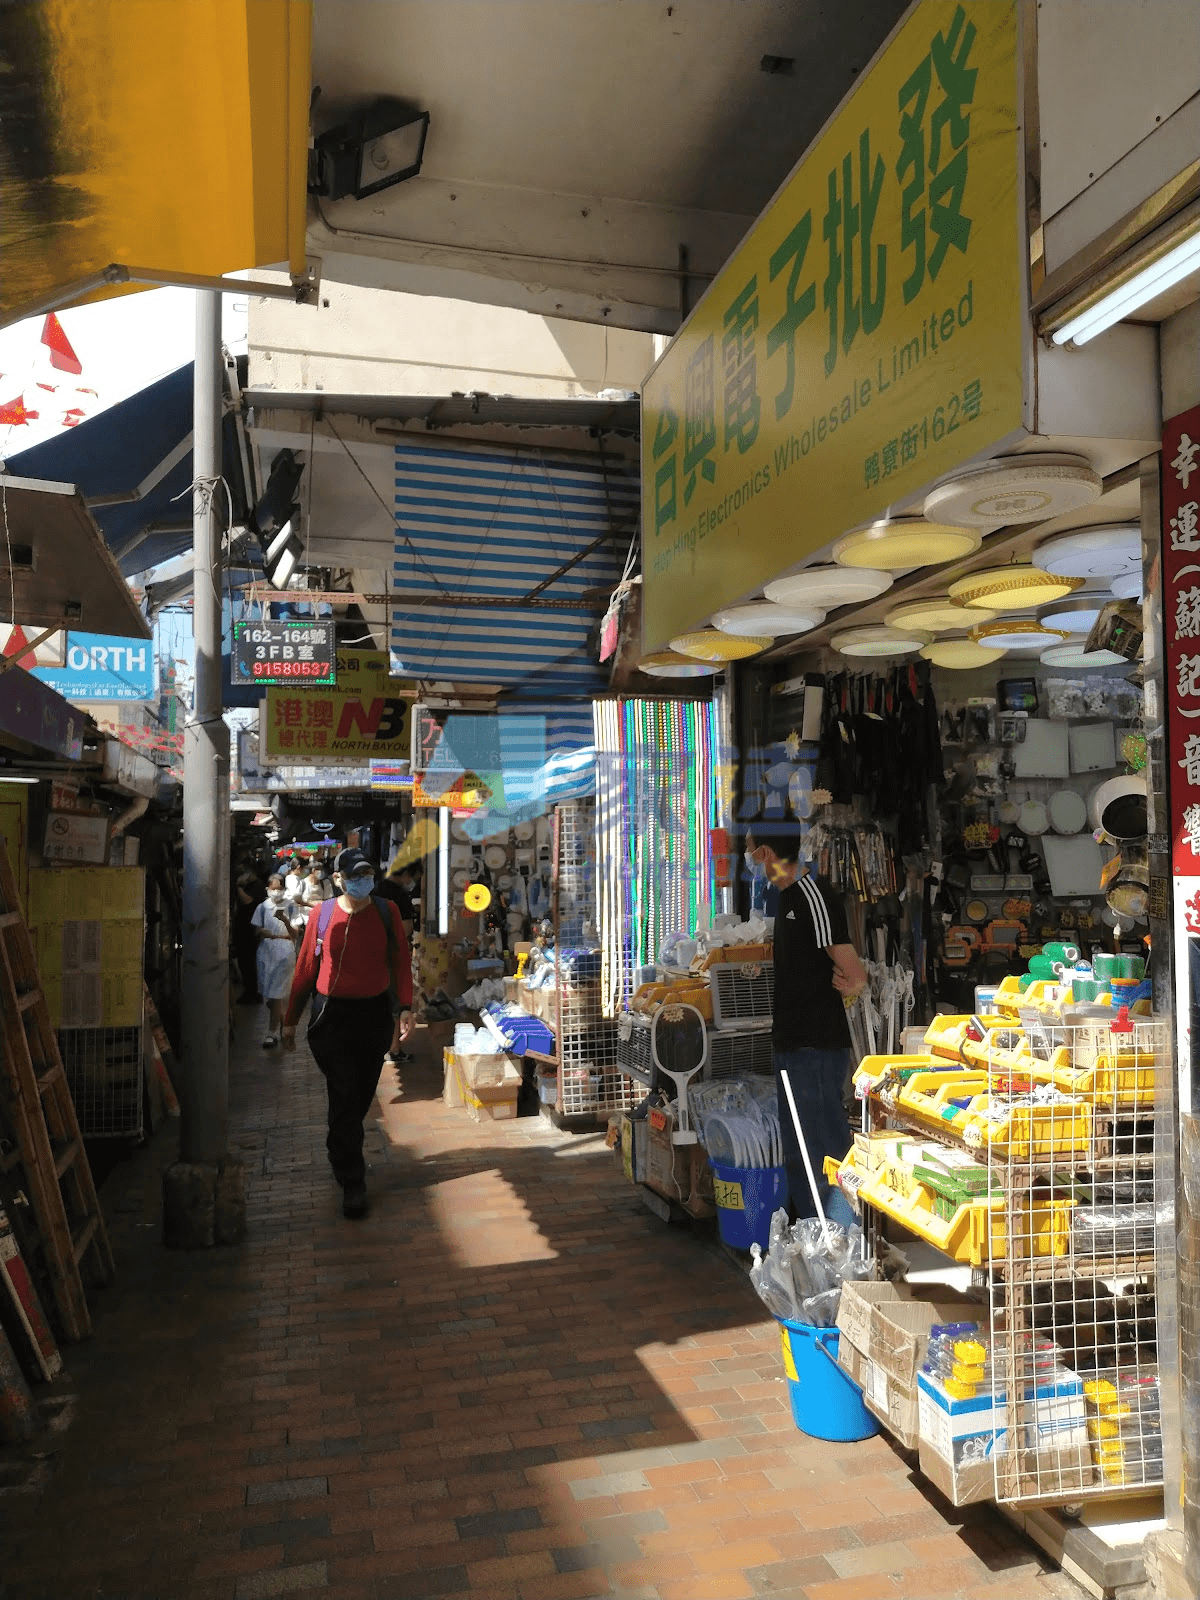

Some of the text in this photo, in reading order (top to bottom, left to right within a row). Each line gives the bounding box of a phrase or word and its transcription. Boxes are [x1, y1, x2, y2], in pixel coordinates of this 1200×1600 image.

[652, 4, 979, 537] 合興電子批發
[673, 525, 698, 558] Hing
[698, 463, 772, 540] Electronics
[773, 377, 873, 478] Wholesale
[876, 279, 977, 393] Limited
[243, 629, 327, 645] 162-164號
[274, 698, 333, 728] 港澳
[336, 697, 408, 740] NB
[278, 729, 329, 749] 總代理
[331, 740, 410, 751] NORTH BAYOU
